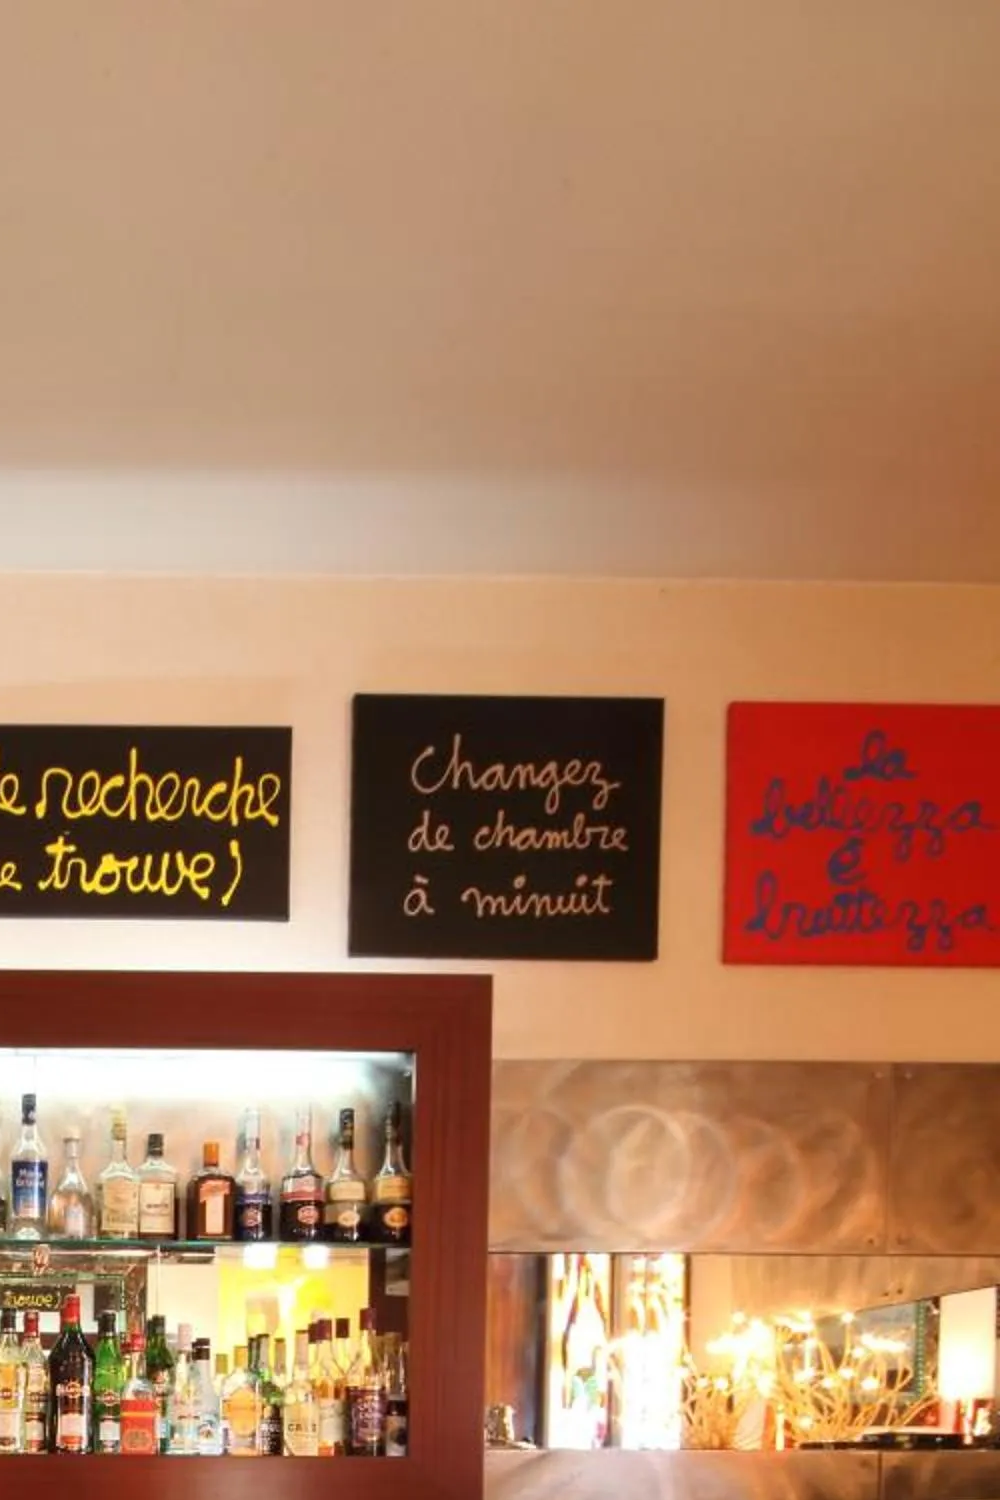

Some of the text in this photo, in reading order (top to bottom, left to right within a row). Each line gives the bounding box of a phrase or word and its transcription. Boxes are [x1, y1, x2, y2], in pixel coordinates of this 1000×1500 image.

[35, 746, 282, 828] recherche
[407, 810, 630, 853] de chambre
[461, 874, 613, 918] minuit
